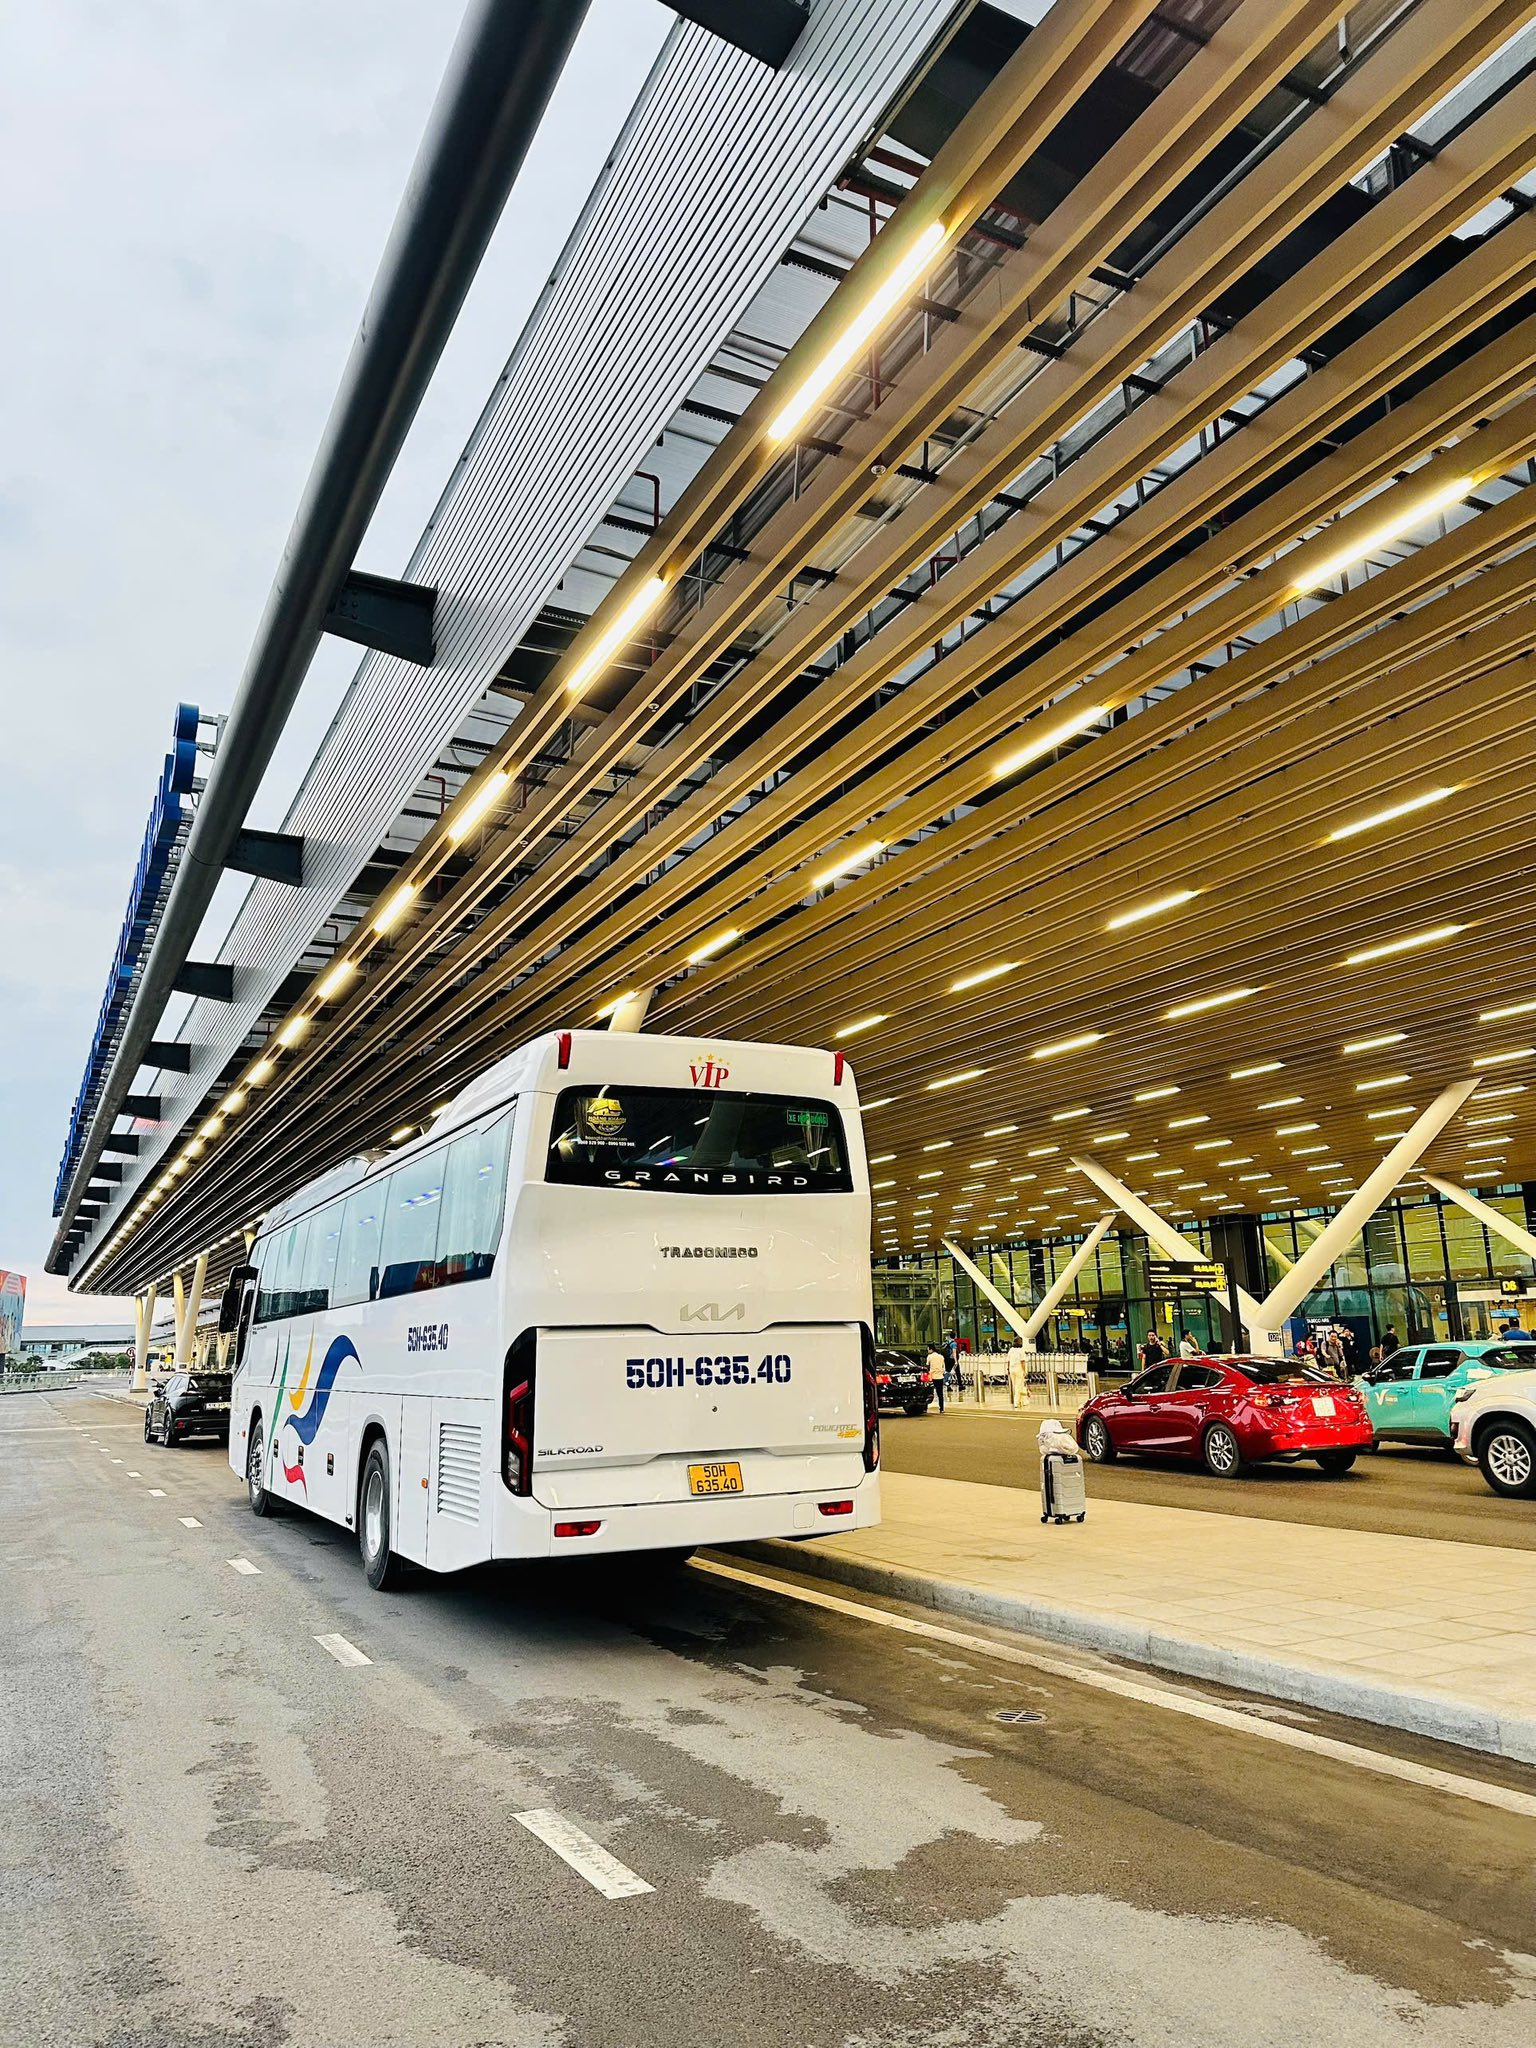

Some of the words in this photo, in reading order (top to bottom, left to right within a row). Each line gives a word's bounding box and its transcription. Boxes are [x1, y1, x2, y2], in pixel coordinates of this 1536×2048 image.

[689, 1061, 730, 1089] VIP
[604, 1169, 809, 1187] GRANBIRD
[660, 1246, 759, 1259] TRACOMECO
[679, 1302, 745, 1322] KIA
[407, 1323, 449, 1352] 50H-635.40
[626, 1354, 792, 1390] 50H-635.40
[537, 1445, 604, 1457] SILKROAD
[703, 1465, 727, 1479] 50H
[696, 1477, 738, 1493] 635.40
